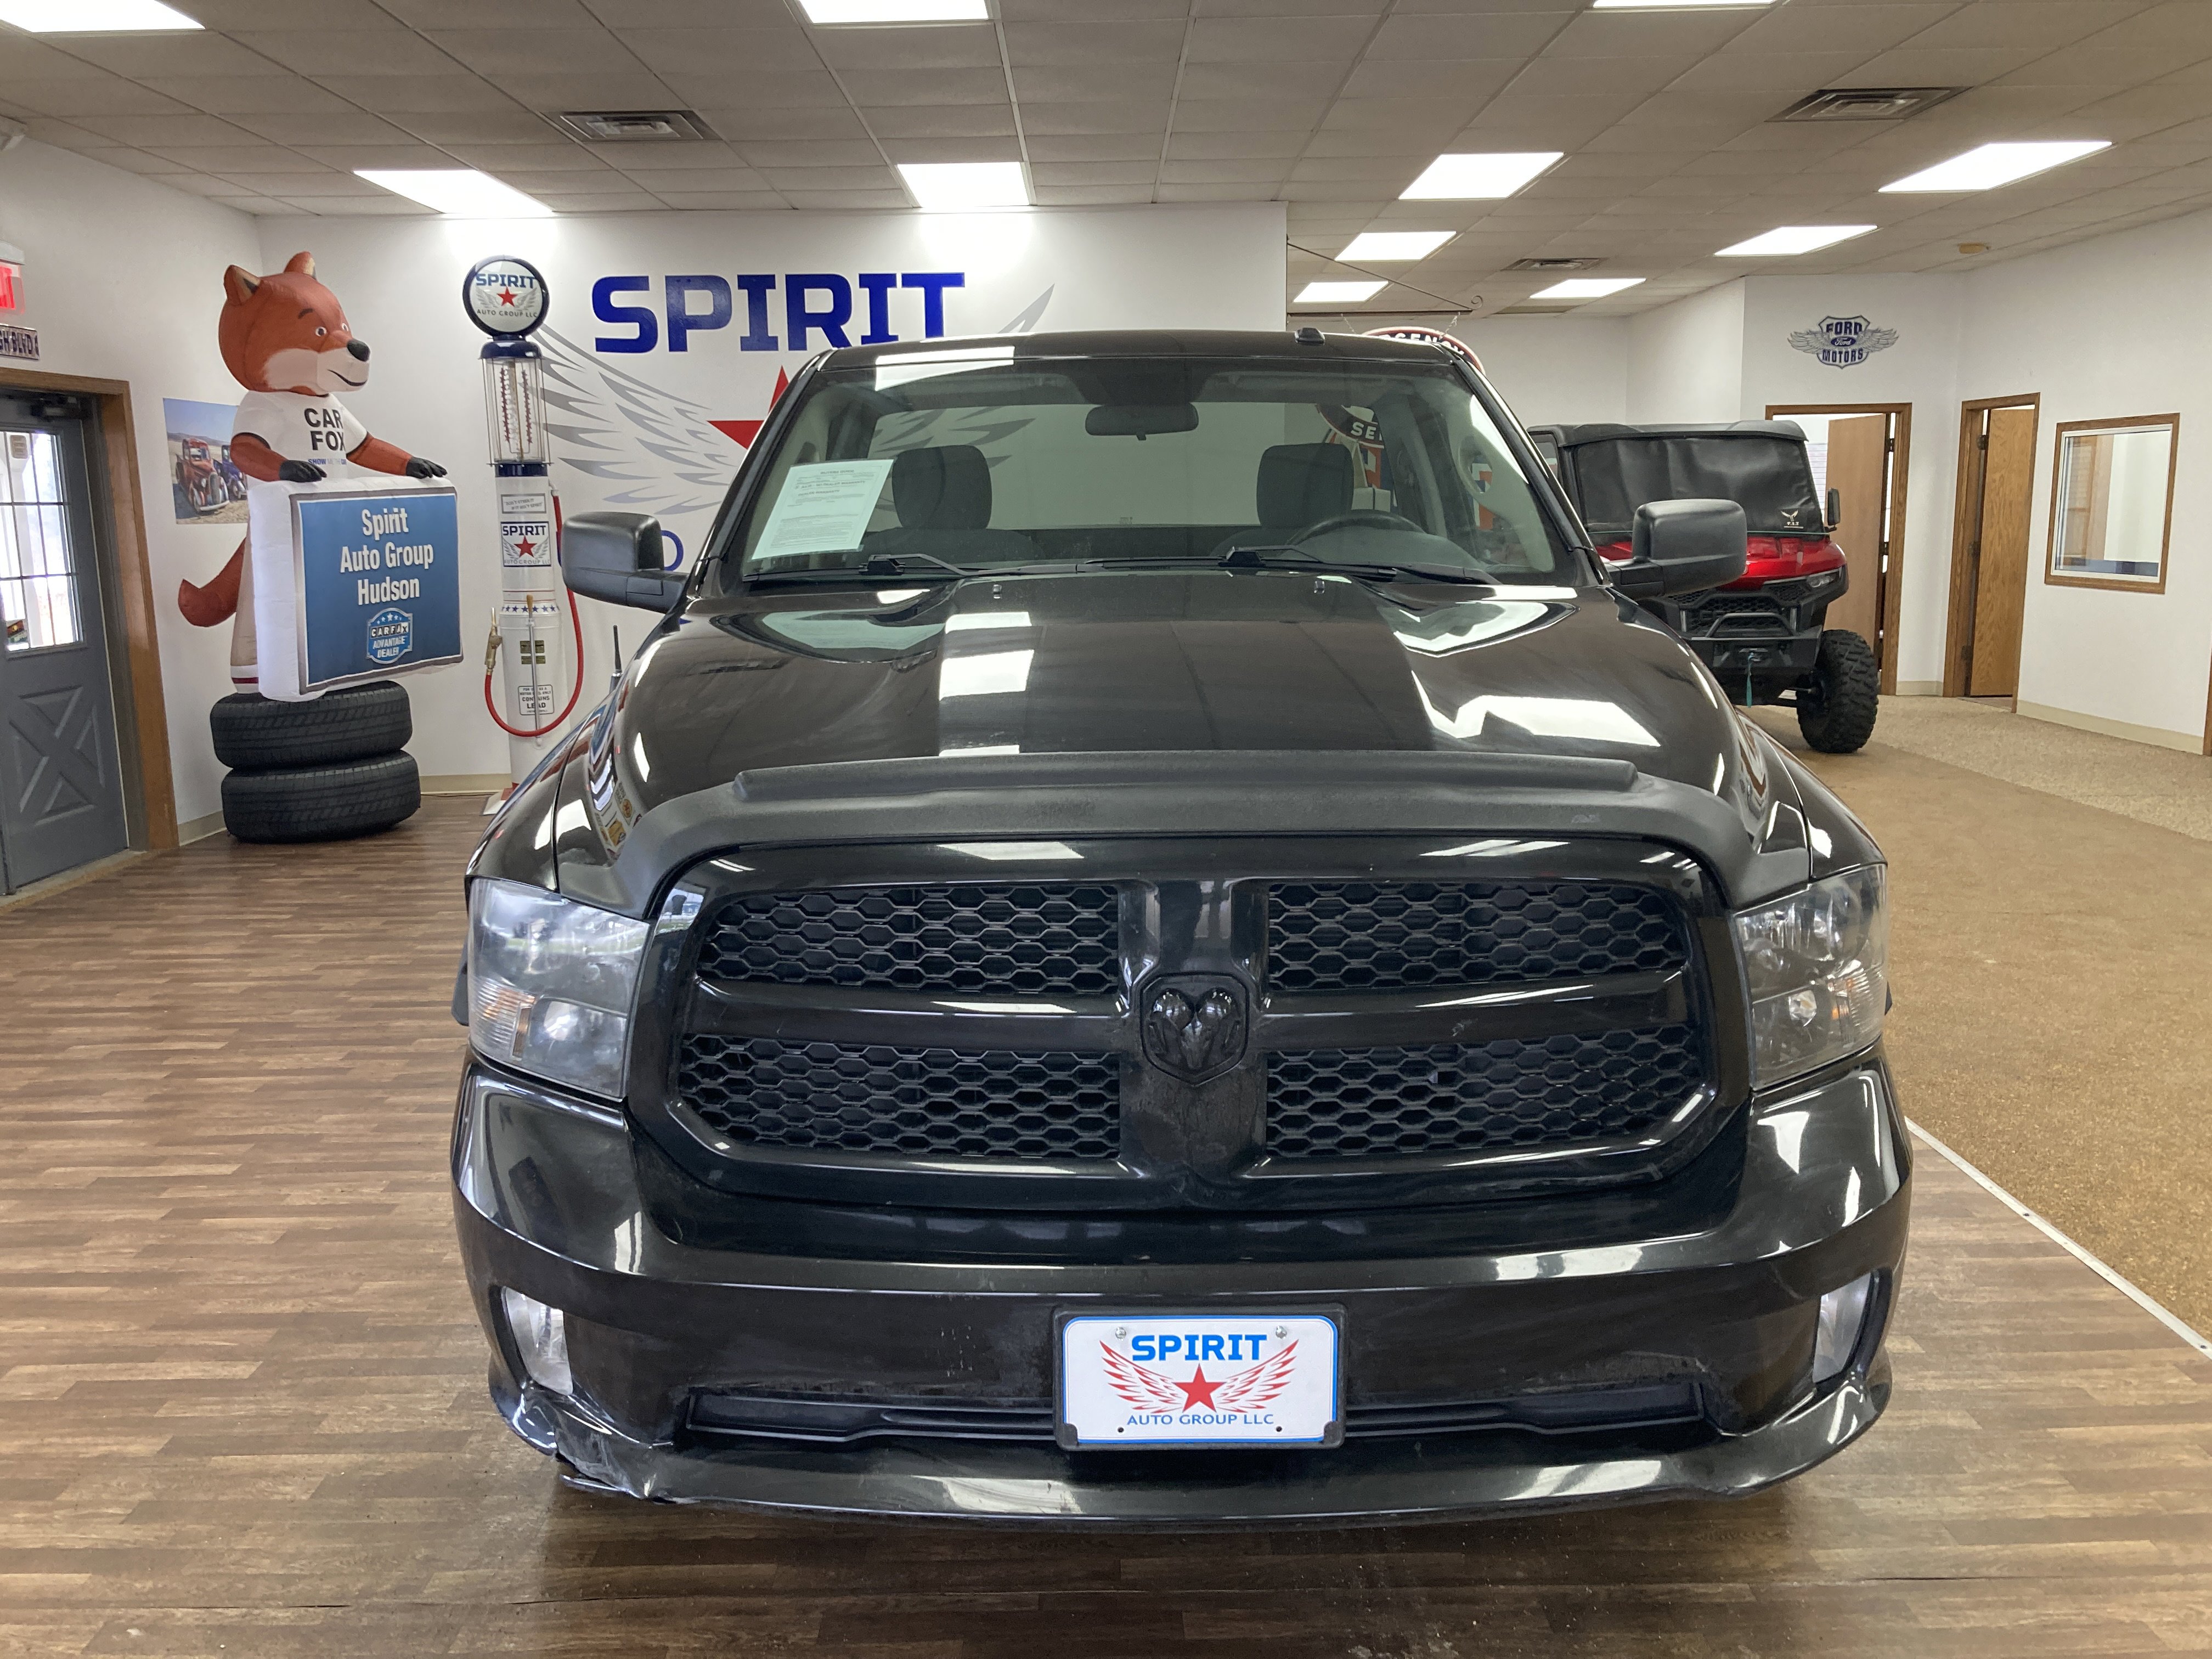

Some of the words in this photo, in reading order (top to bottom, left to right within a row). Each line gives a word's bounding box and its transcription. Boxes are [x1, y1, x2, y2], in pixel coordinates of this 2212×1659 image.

[476, 273, 535, 289] SPIRIT
[591, 272, 965, 353] SPIRIT
[1826, 321, 1863, 336] FORD
[1822, 348, 1864, 363] MOTORS
[304, 408, 343, 429] CAR
[1351, 421, 1383, 441] SE
[310, 431, 346, 452] FOX
[362, 507, 409, 540] Spirit
[503, 526, 546, 535] SPIRIT
[340, 545, 381, 573] Auto
[385, 541, 433, 569] Group
[358, 576, 420, 606] Hudson
[371, 623, 408, 637] CARFAX
[373, 636, 406, 650] ADVANTAGE
[377, 647, 399, 658] DEALER
[1132, 1334, 1267, 1361] SPIRIT
[1127, 1415, 1173, 1425] AUTO
[1180, 1414, 1237, 1425] GROUP
[1244, 1414, 1274, 1425] LLC
